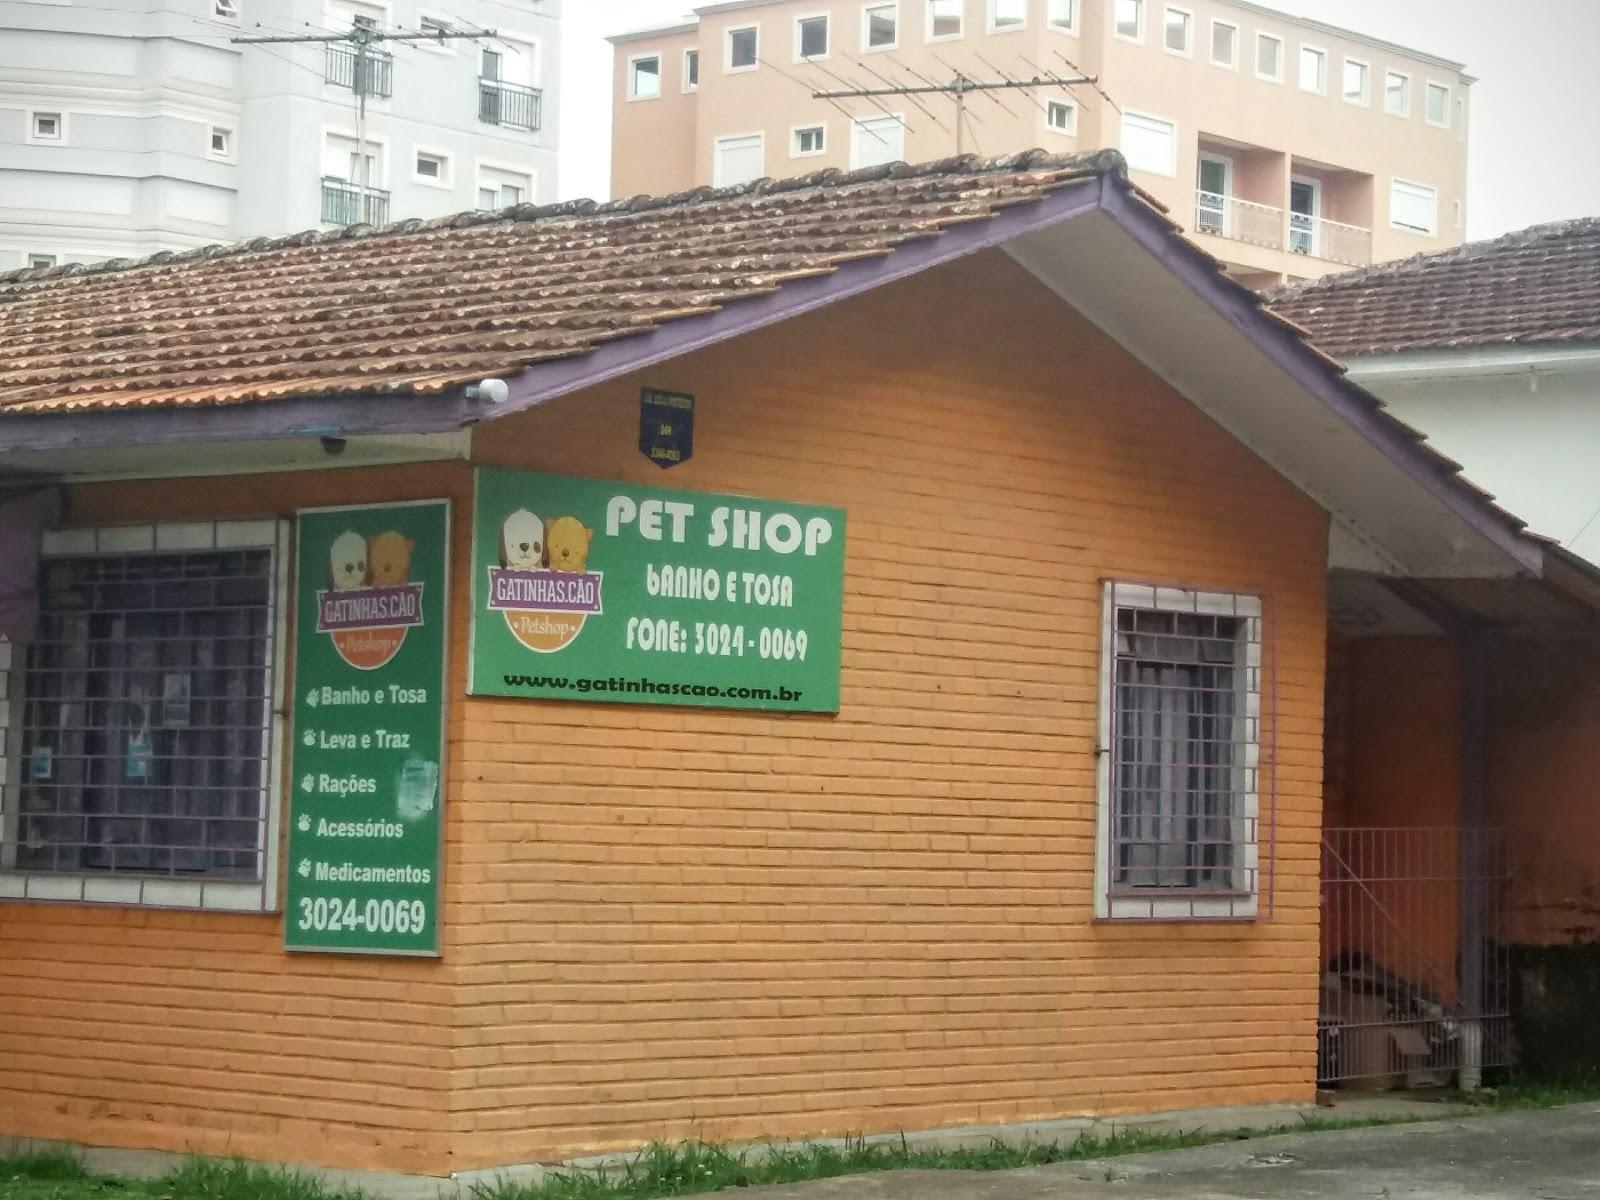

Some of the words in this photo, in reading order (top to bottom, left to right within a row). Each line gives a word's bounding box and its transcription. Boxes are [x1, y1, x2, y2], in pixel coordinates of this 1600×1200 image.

[606, 495, 694, 543] PET
[708, 507, 833, 556] SHOP
[726, 571, 737, 602] E
[743, 573, 793, 607] TOSA
[520, 614, 569, 641] Petshop
[626, 617, 687, 653] FONE:
[321, 686, 370, 705] Banho
[374, 688, 385, 705] e
[389, 684, 427, 705] Tosa
[503, 673, 803, 702] www.gatinhascao.com.br
[320, 730, 356, 749] Leva
[361, 732, 371, 749] e
[375, 730, 411, 749] Traz
[318, 774, 377, 798] Rações
[317, 817, 404, 838] Acessórios
[315, 862, 431, 884] Medicamentos
[298, 896, 426, 934] 3024-0069
